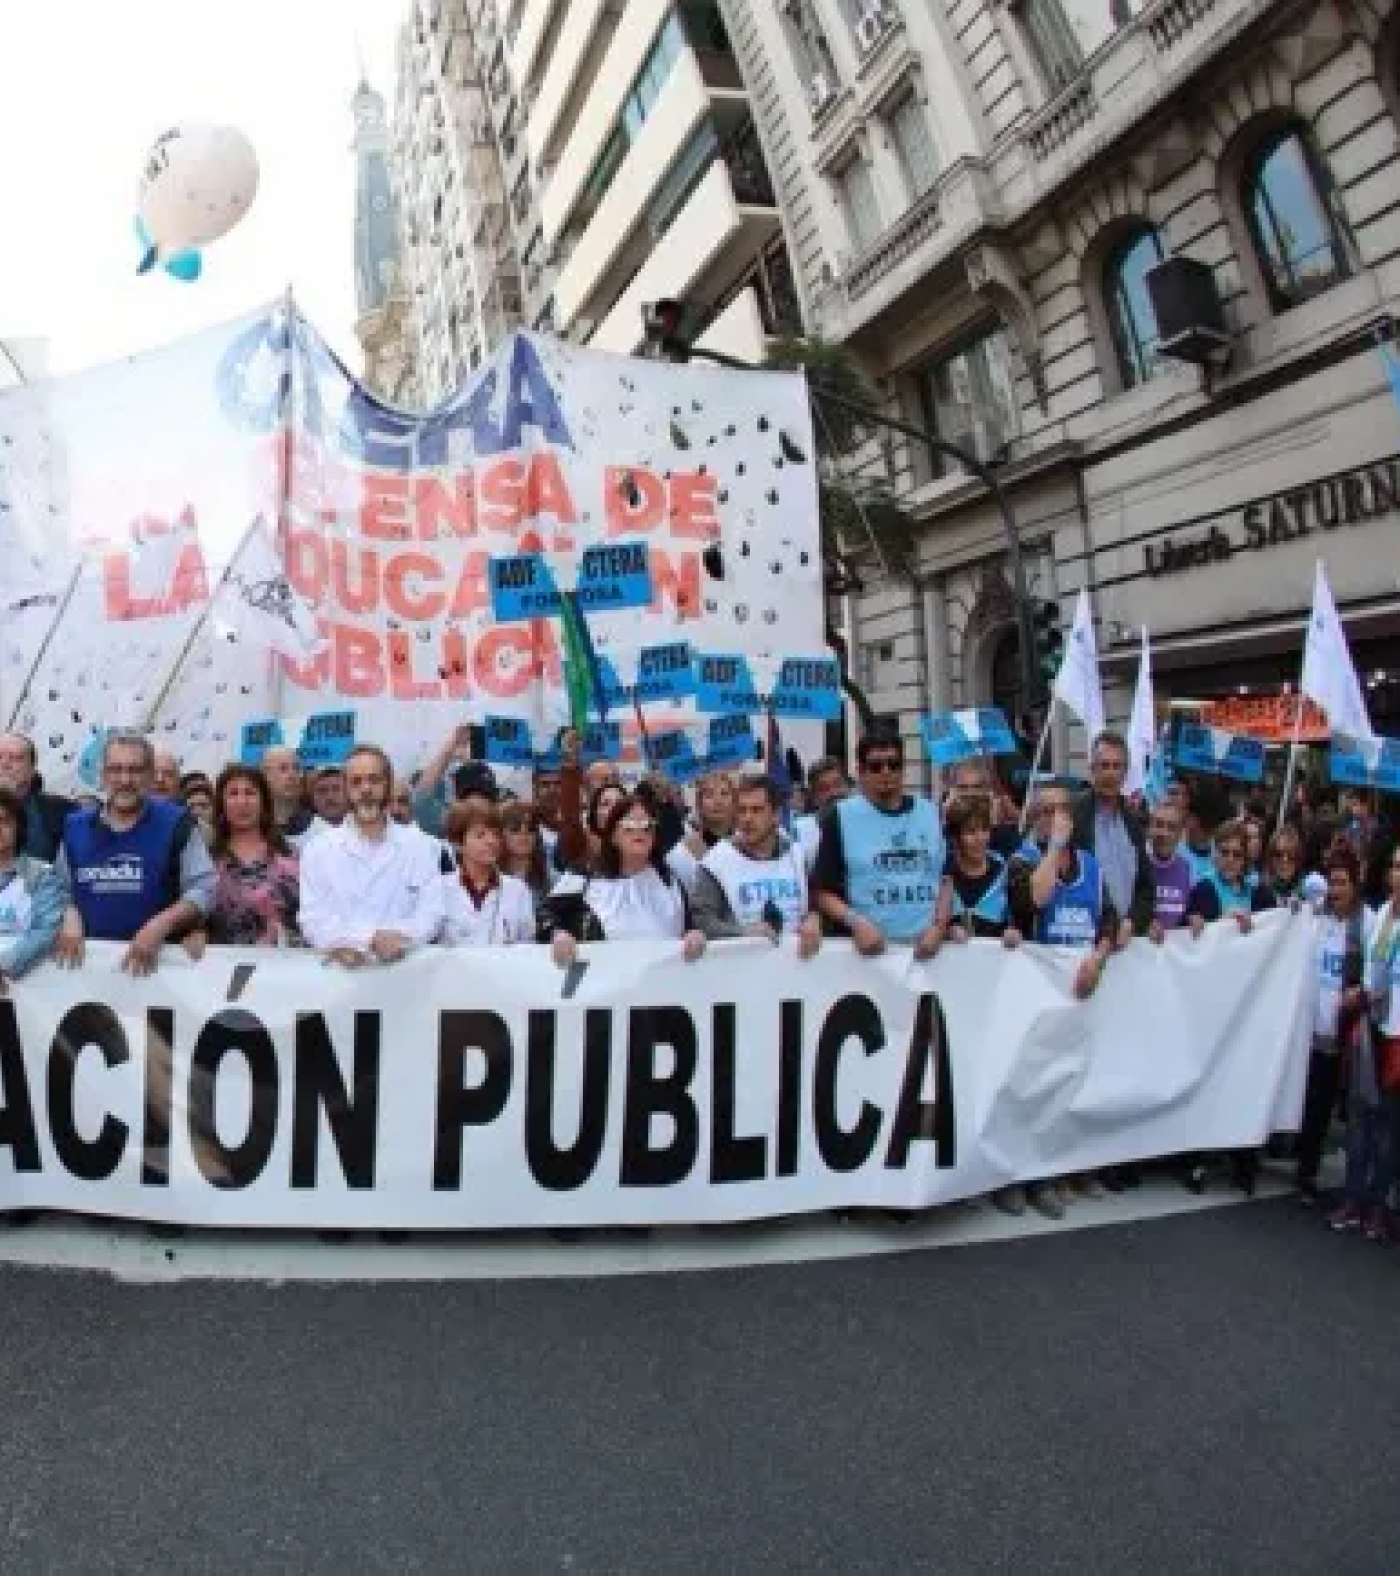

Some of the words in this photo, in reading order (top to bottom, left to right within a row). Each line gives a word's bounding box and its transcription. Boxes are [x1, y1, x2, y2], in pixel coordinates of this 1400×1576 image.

[603, 463, 722, 541] DE
[495, 560, 538, 590] ADF
[582, 544, 649, 580] CTERA
[519, 587, 624, 610] FOROSA
[701, 658, 739, 684] ADF
[780, 658, 839, 689] CTERA
[432, 961, 956, 1192] PÚBLICA
